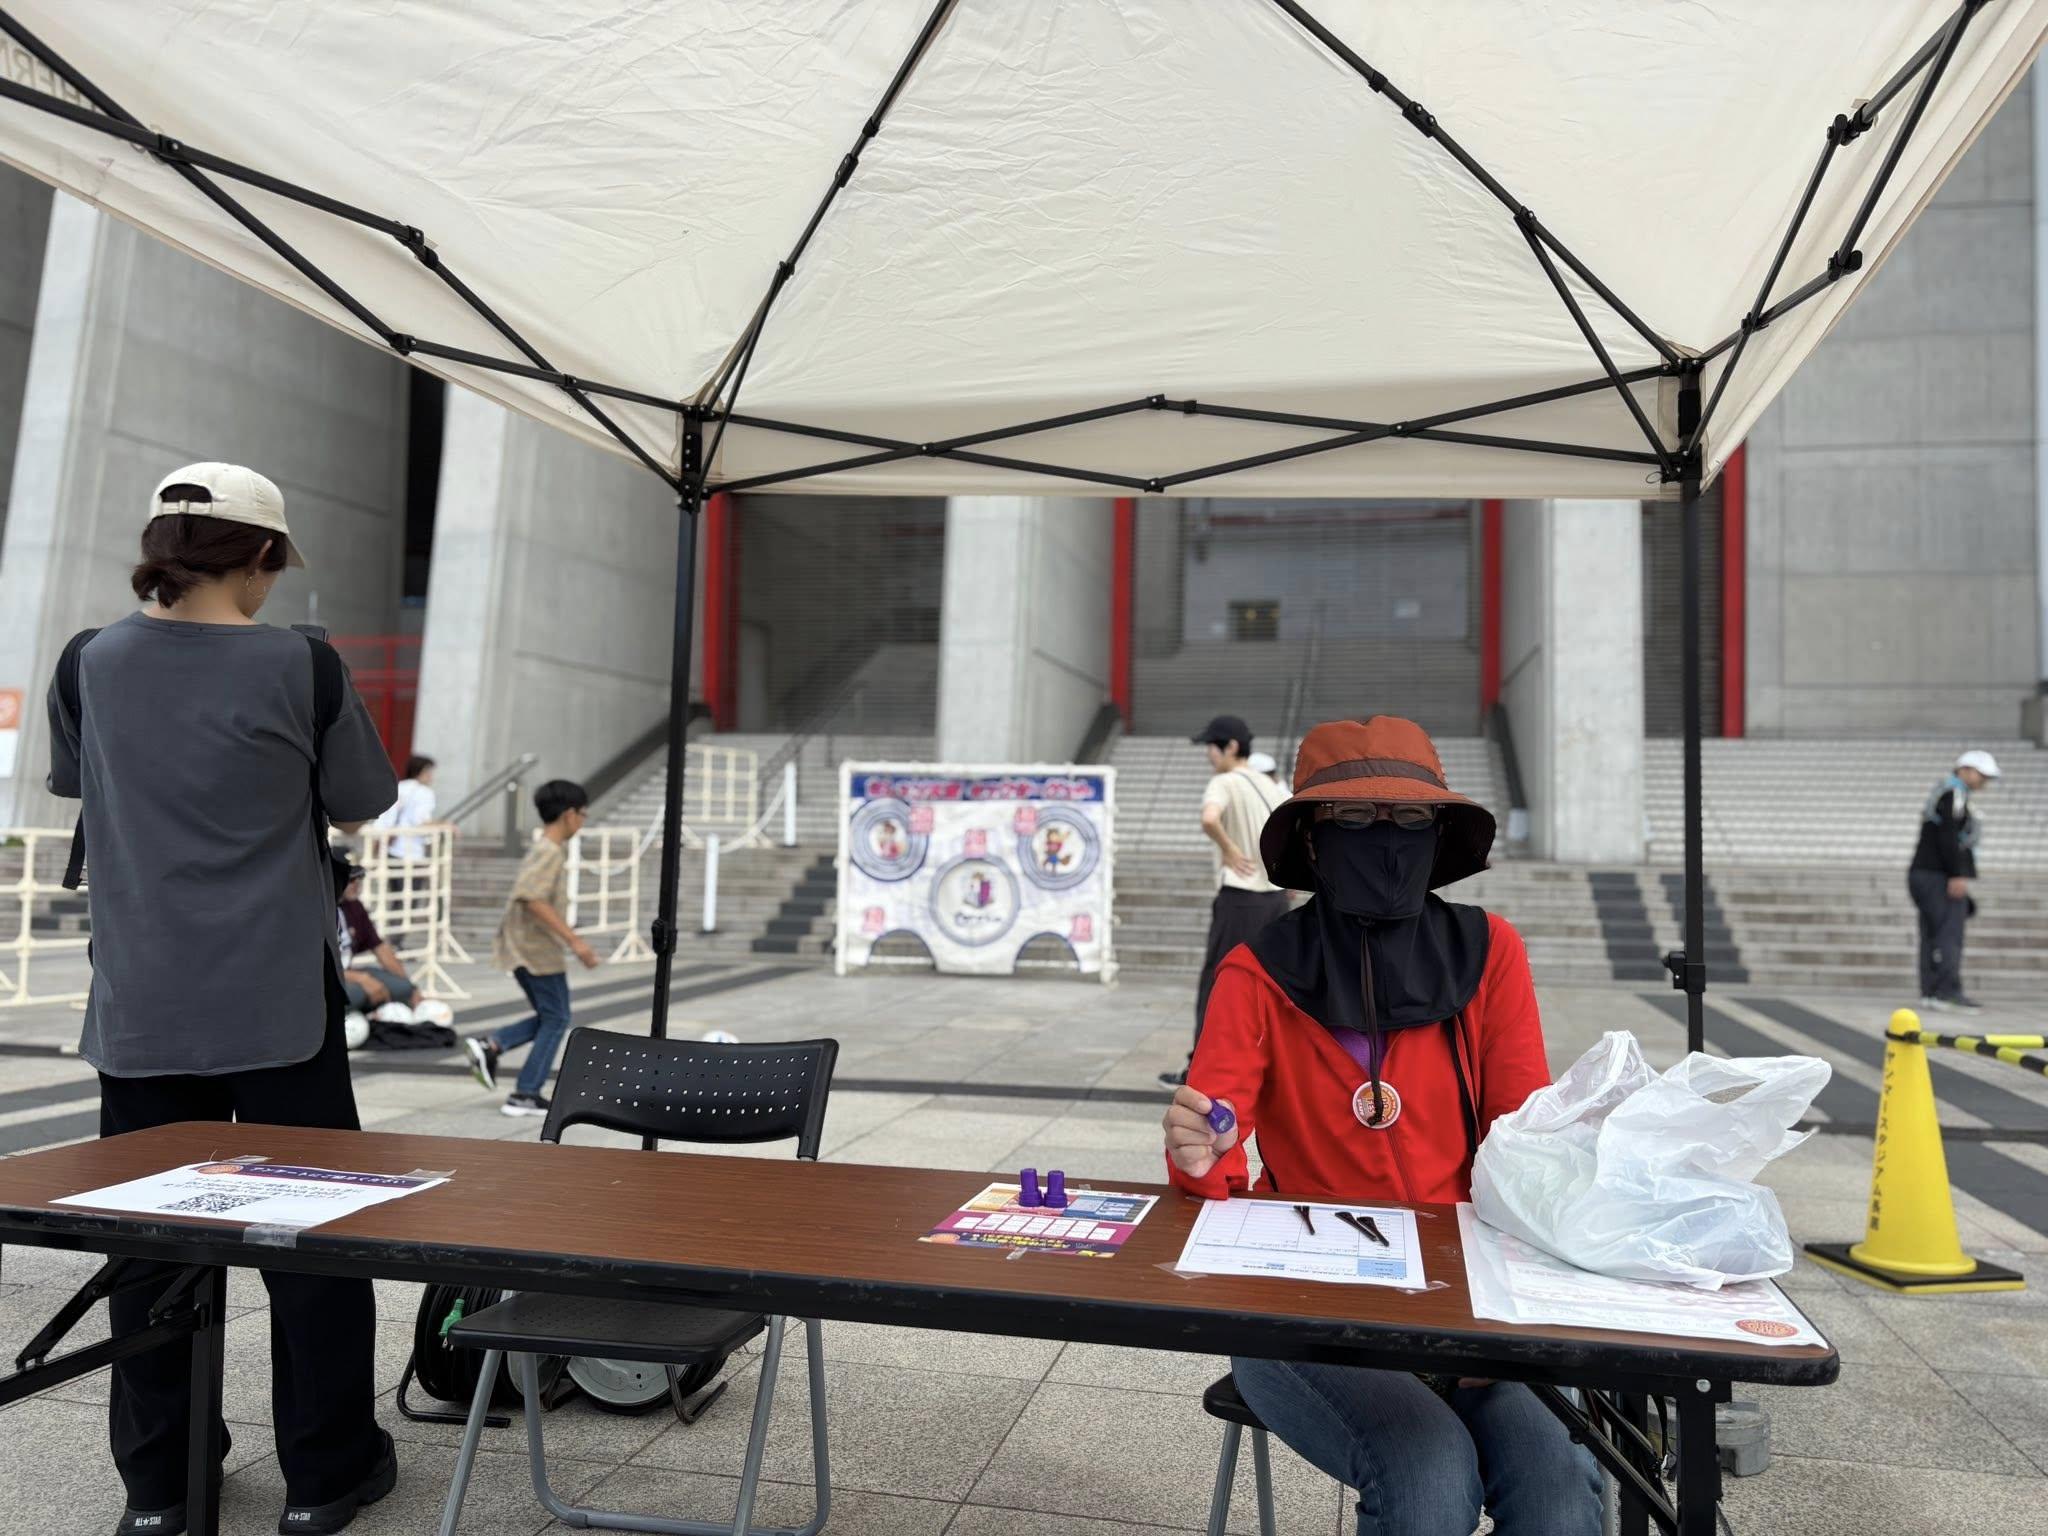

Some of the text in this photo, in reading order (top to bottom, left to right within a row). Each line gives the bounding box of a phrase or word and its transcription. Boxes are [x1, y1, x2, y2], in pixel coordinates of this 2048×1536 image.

[134, 1515, 161, 1526] ALL STAR
[299, 1512, 311, 1520] STAR
